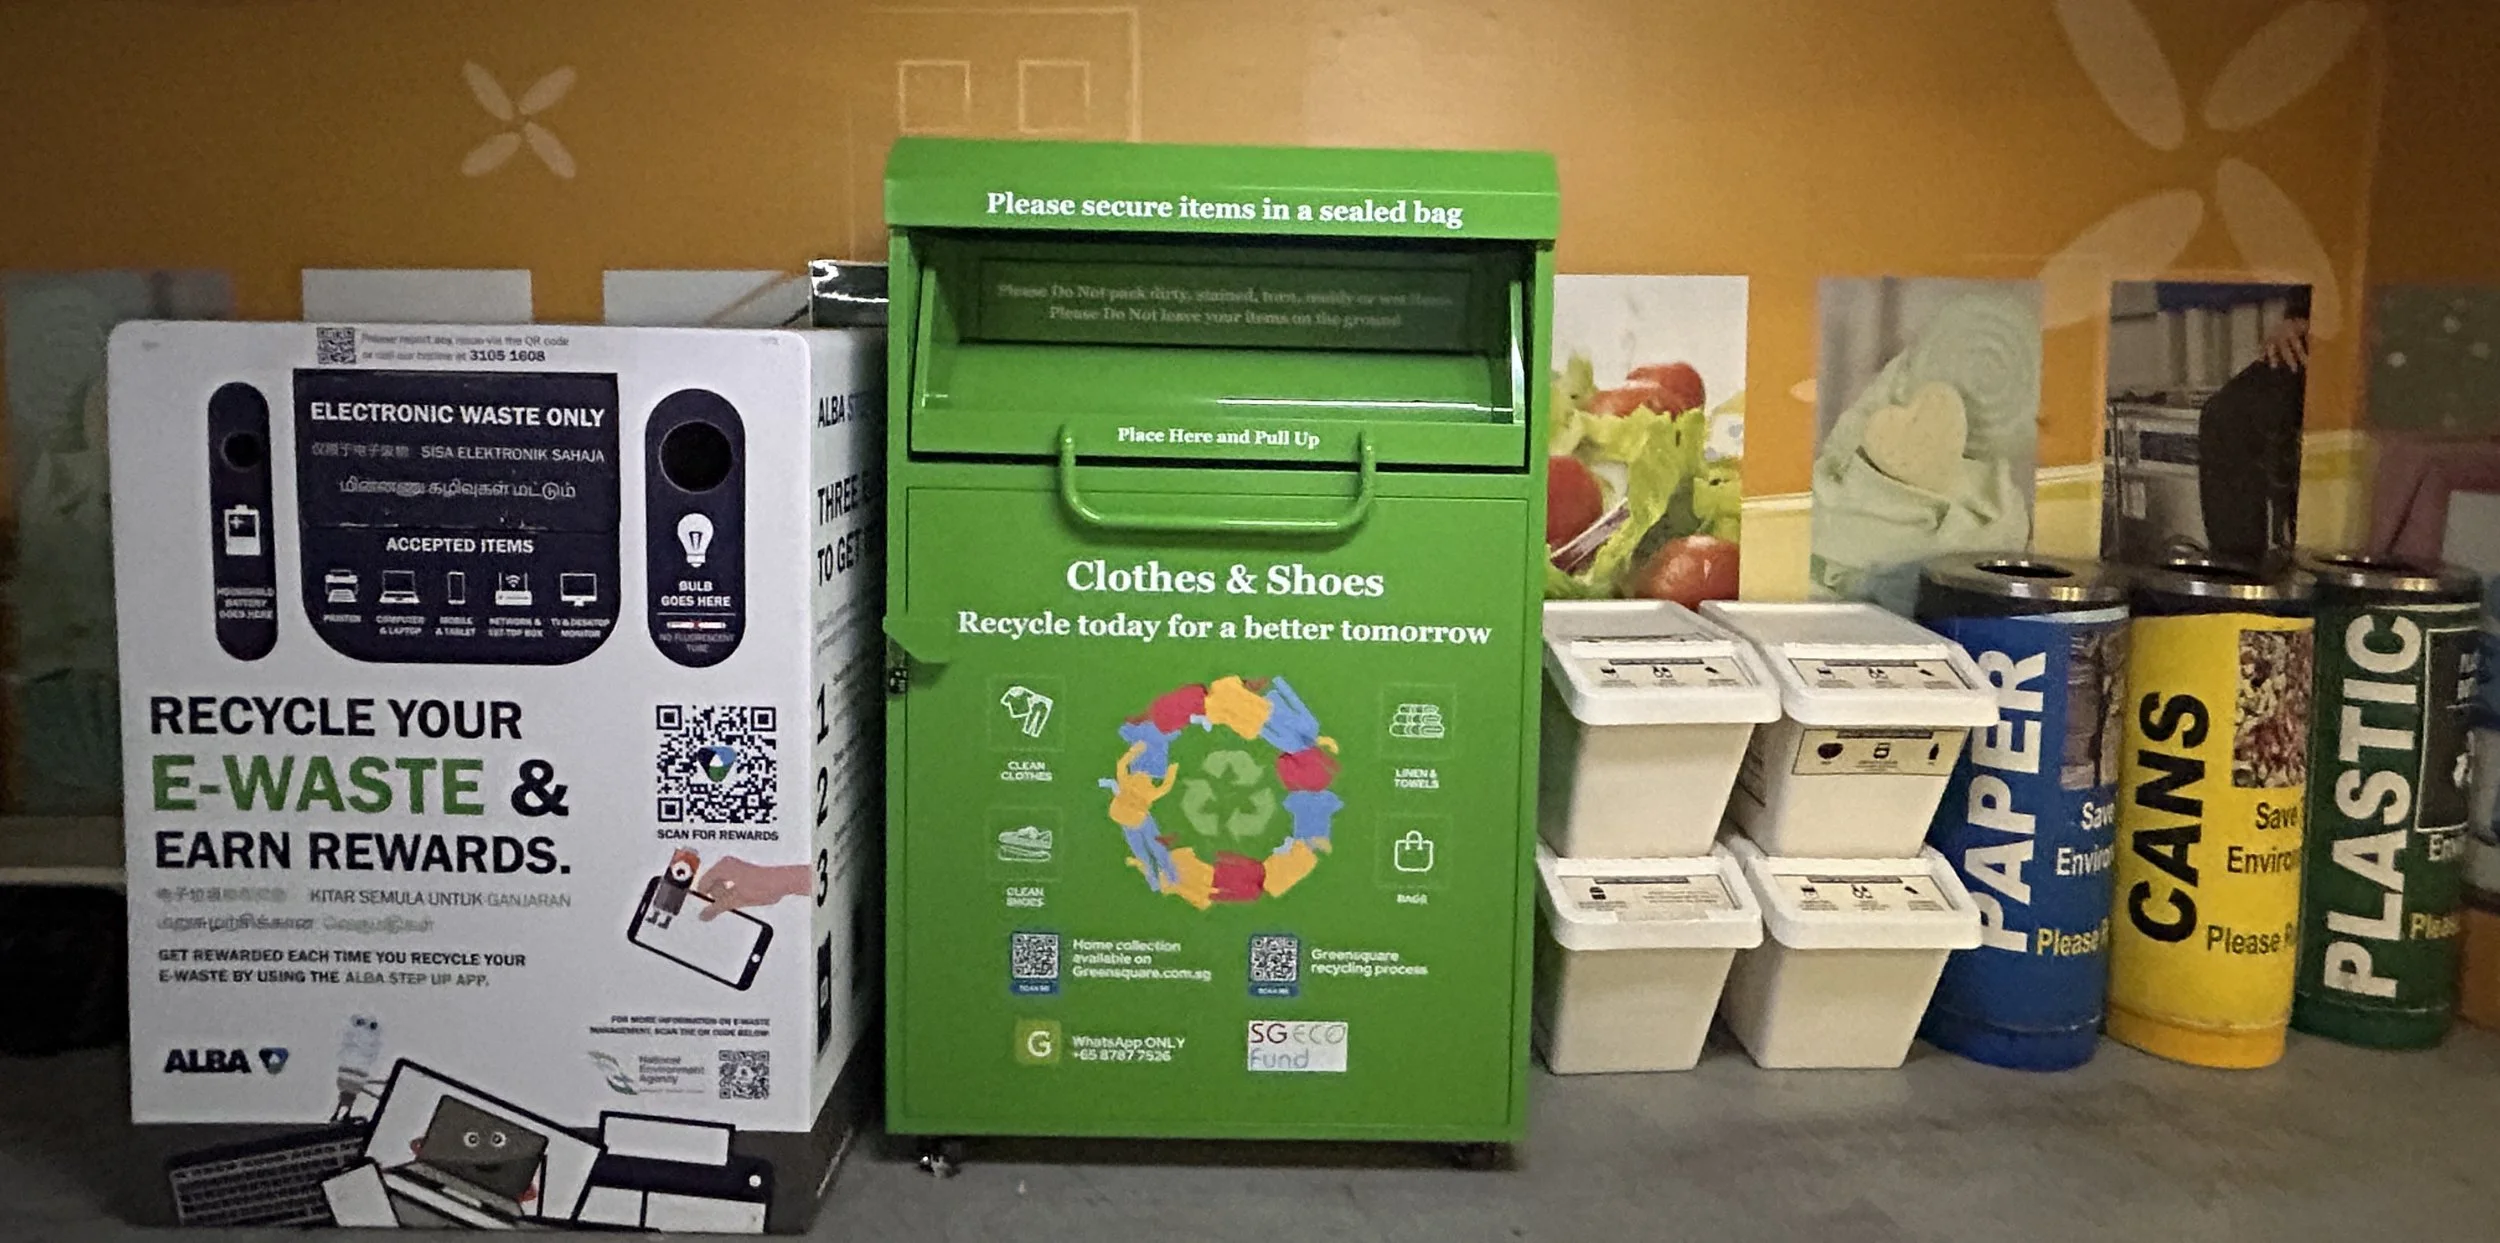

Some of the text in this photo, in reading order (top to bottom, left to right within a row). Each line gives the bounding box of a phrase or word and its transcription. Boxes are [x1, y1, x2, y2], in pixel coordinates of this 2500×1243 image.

[986, 191, 1464, 228] Please secure items in a sealed bag
[1050, 284, 1073, 298] Do
[1077, 285, 1105, 299] Not
[1103, 307, 1126, 321] Do
[1129, 308, 1158, 322] Not
[525, 334, 541, 347] QR
[469, 350, 505, 361] 3105
[509, 350, 546, 362] 1608
[310, 401, 606, 427] ELECTRONIC WASTE ONLY
[818, 394, 845, 429] ALBA
[1117, 427, 1321, 450] Place Here and Pull Up
[421, 445, 605, 463] SISA ELEKTRONIK SAHAJA
[817, 473, 859, 527] THREE
[386, 537, 535, 554] ACCEPTED ITEMS
[817, 542, 834, 587] TO
[837, 527, 862, 574] GET
[678, 580, 713, 592] BULB
[1066, 559, 1385, 598] Clothes & Shoes
[660, 595, 731, 607] GOES HERE
[439, 616, 474, 625] MOBILE
[958, 610, 1492, 645] Recycle today for a better tomorrow
[388, 626, 423, 636] LAPTOP
[150, 695, 523, 740] RECYCLE YOUR
[816, 682, 829, 745] 1
[1007, 760, 1046, 770] CLEAN
[151, 753, 570, 818] E-WASTE &
[1000, 771, 1053, 781] CLOTHES
[1394, 778, 1440, 789] TOWELS
[816, 766, 828, 828] 2
[1963, 648, 2048, 953] PAPER
[2323, 613, 2422, 999] PLASTIC
[2127, 691, 2209, 943] CANS
[2255, 802, 2298, 830] Save
[657, 828, 779, 842] SCAN FOR REWARDS
[155, 829, 572, 876] EARN REWARDS.
[816, 848, 828, 908] 3
[310, 889, 572, 908] KITAR SEMULA UNTUK GANJARAN
[1006, 886, 1045, 897] CLEAN
[1072, 939, 1182, 952] Home collection
[2036, 927, 2101, 957] Please
[2207, 924, 2281, 954] Please
[158, 948, 526, 967] GET REWARDED EACH TIME YOU RECYCLE YOUR
[1072, 952, 1152, 964] available on
[1311, 948, 1400, 963] Greensquare
[159, 969, 228, 983] E-WASTE
[233, 969, 254, 983] BY
[257, 969, 306, 983] USING
[309, 970, 341, 984] THE
[345, 971, 385, 984] ALBA
[388, 972, 427, 986] STEP
[430, 973, 451, 986] UP
[1072, 966, 1212, 982] Greensquare.com.sg
[1311, 962, 1429, 977] recycling process
[1072, 1036, 1186, 1050] WhatsApp ONLY
[1251, 1023, 1347, 1045] SG ECO
[1027, 1030, 1052, 1058] G
[163, 1048, 252, 1074] ALBA
[1072, 1049, 1172, 1062] +65 8787 7526
[1251, 1048, 1309, 1069] Fund
